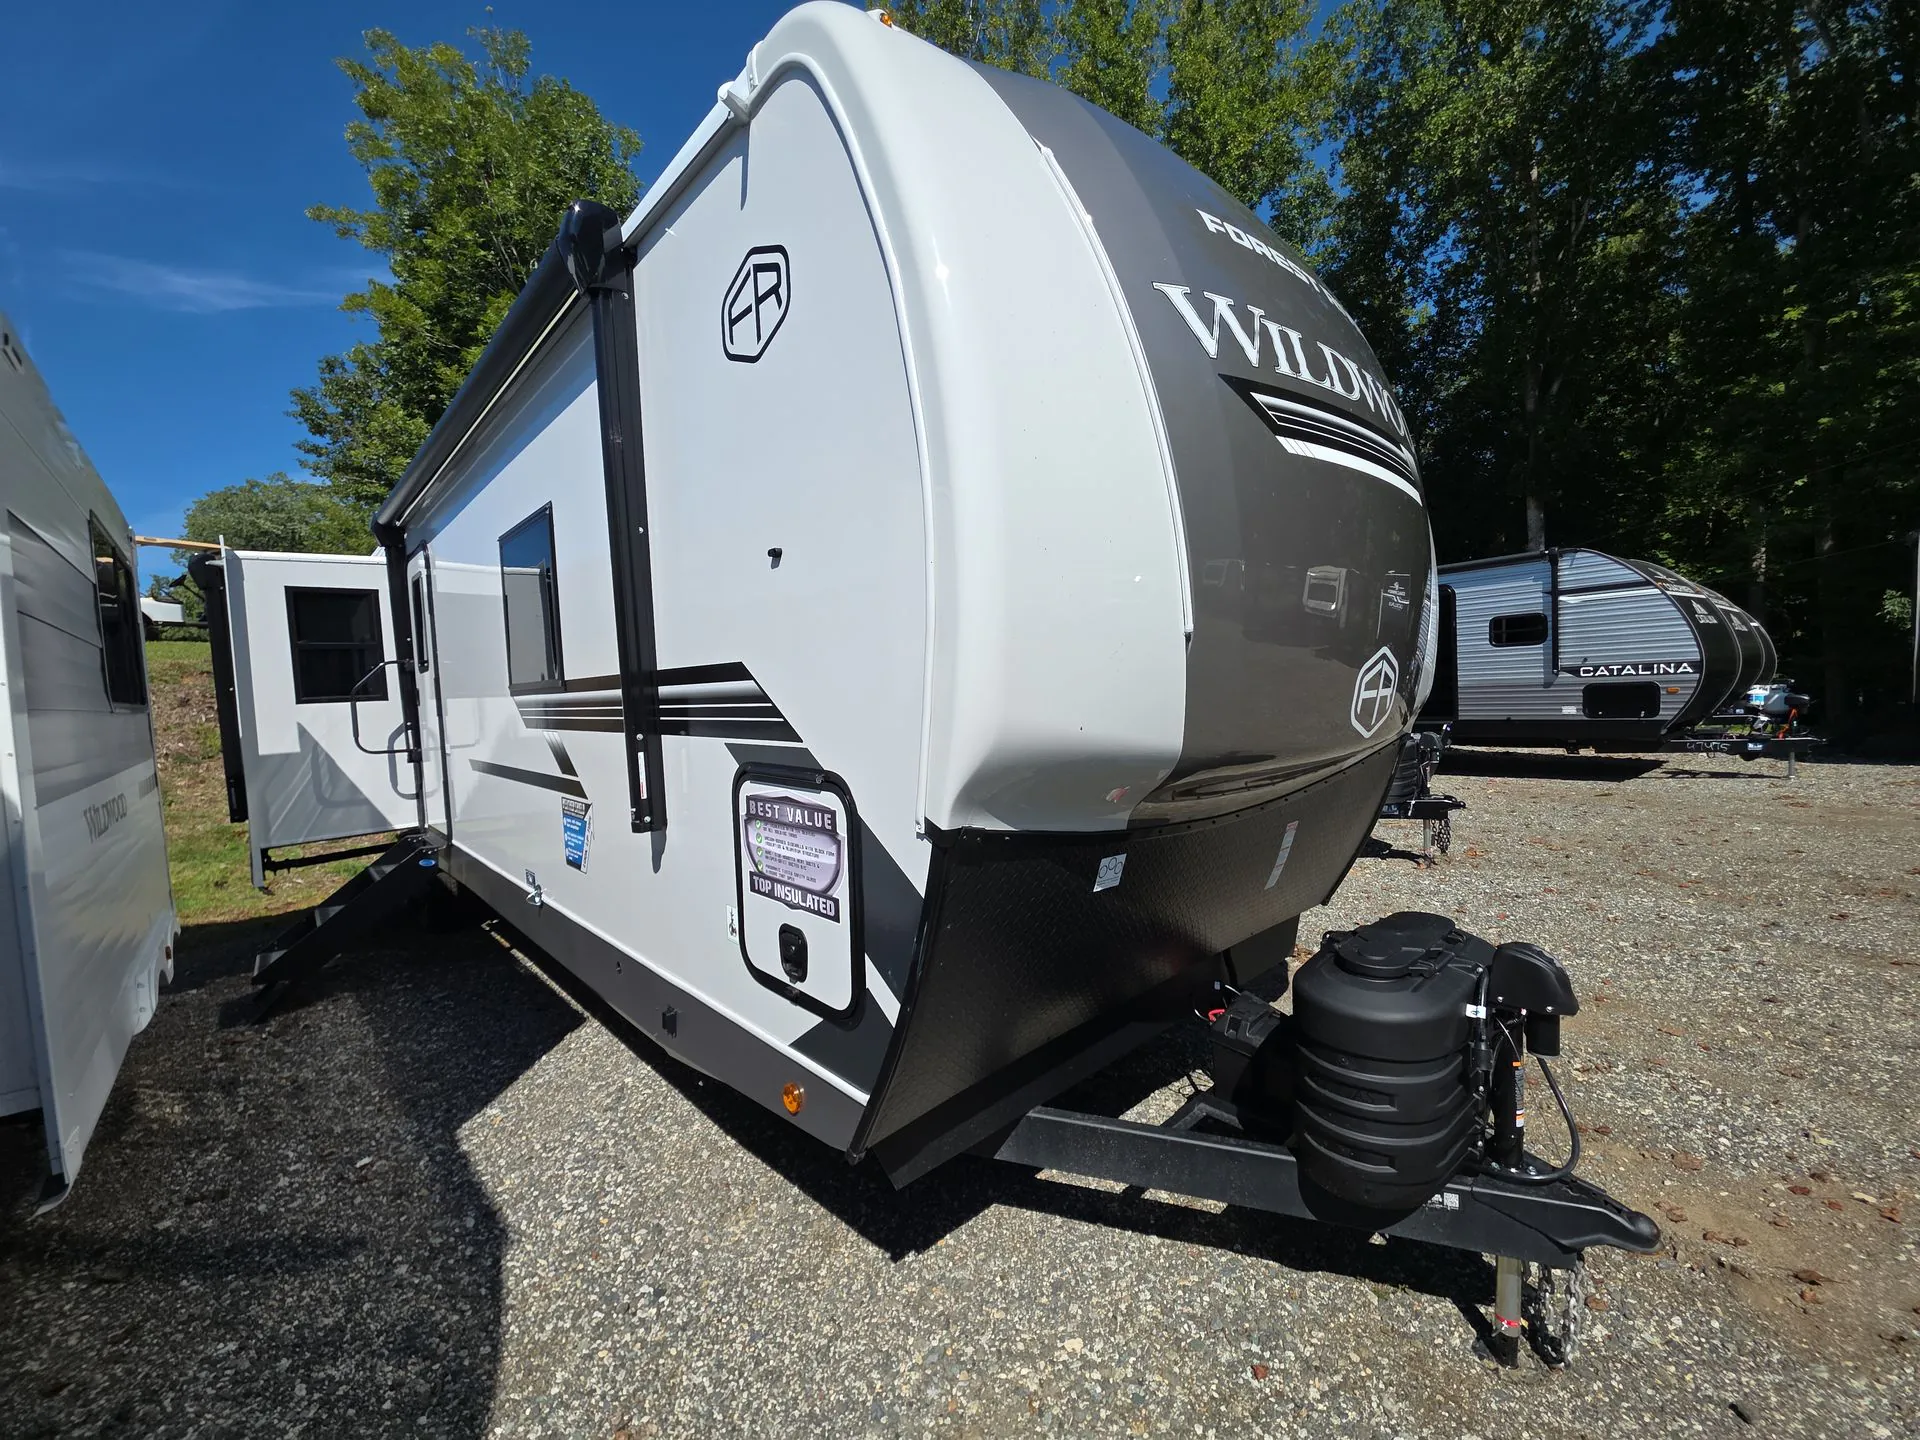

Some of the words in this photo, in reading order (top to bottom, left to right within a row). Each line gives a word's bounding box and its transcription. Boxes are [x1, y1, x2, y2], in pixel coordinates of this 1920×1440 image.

[1196, 208, 1320, 293] FOREST
[1152, 281, 1415, 453] WILDWO
[1580, 662, 1694, 677] CATALINA
[749, 800, 780, 819] BEST
[786, 807, 832, 830] VALUE
[752, 875, 772, 894] TOP
[774, 883, 835, 917] INSULATED
